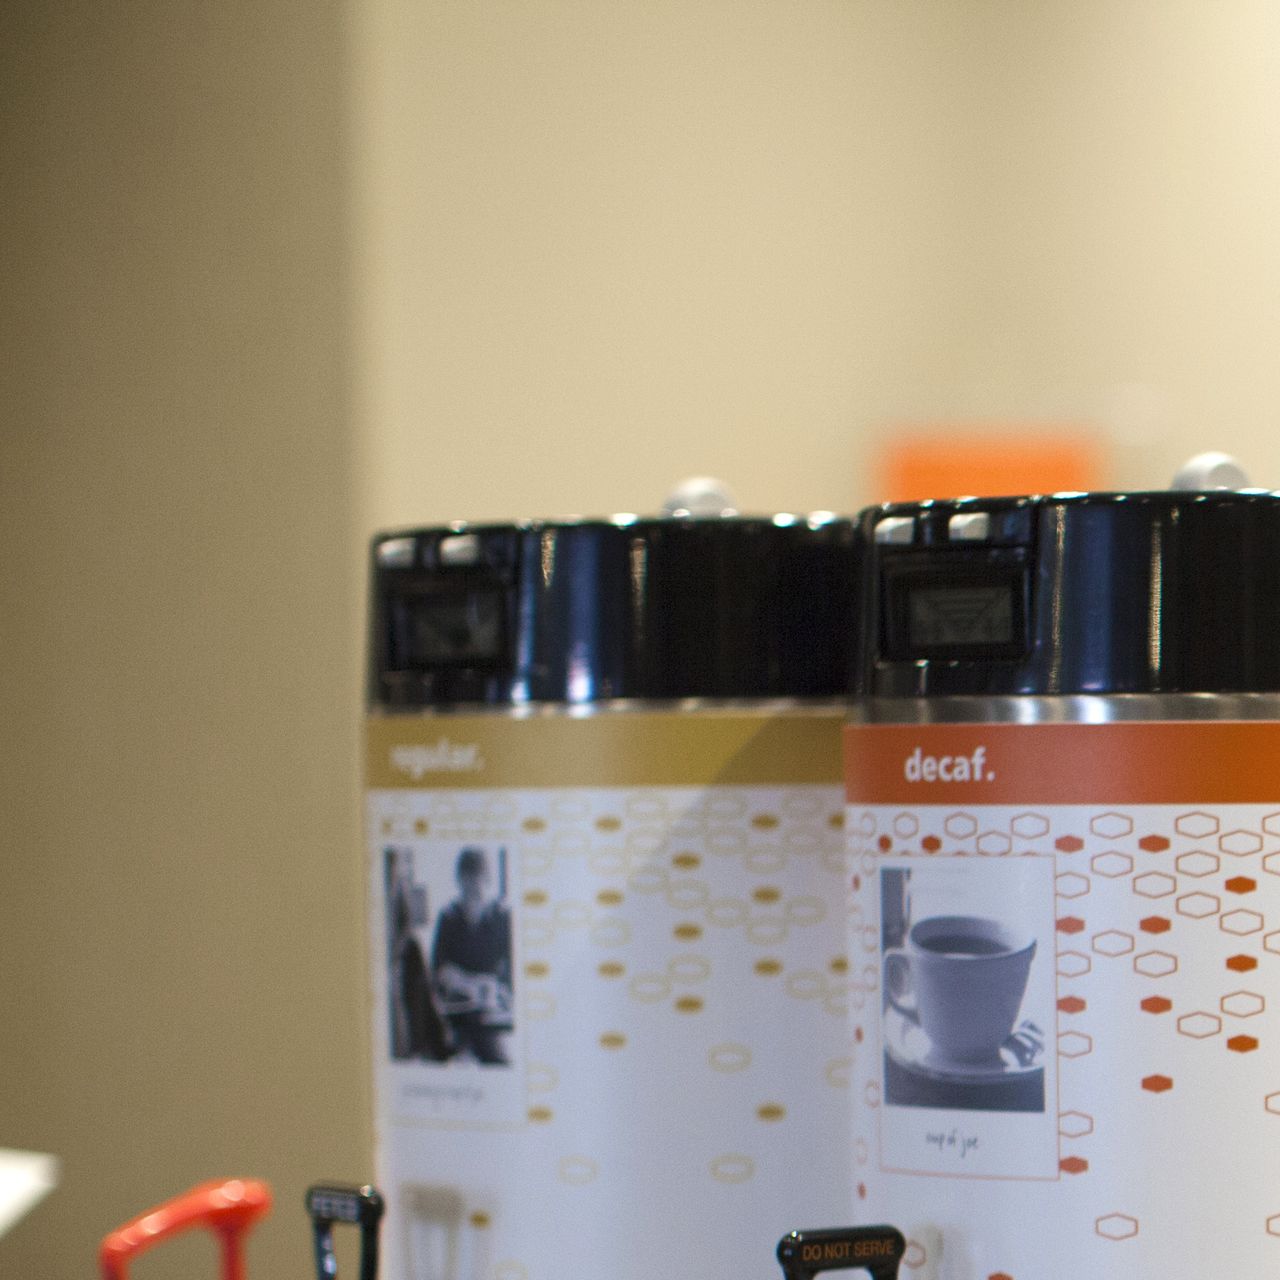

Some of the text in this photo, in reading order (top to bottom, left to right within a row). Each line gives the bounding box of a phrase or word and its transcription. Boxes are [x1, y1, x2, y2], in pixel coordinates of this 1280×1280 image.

[904, 746, 996, 782] decaf.
[803, 1239, 894, 1261] DO NOT SERVE
